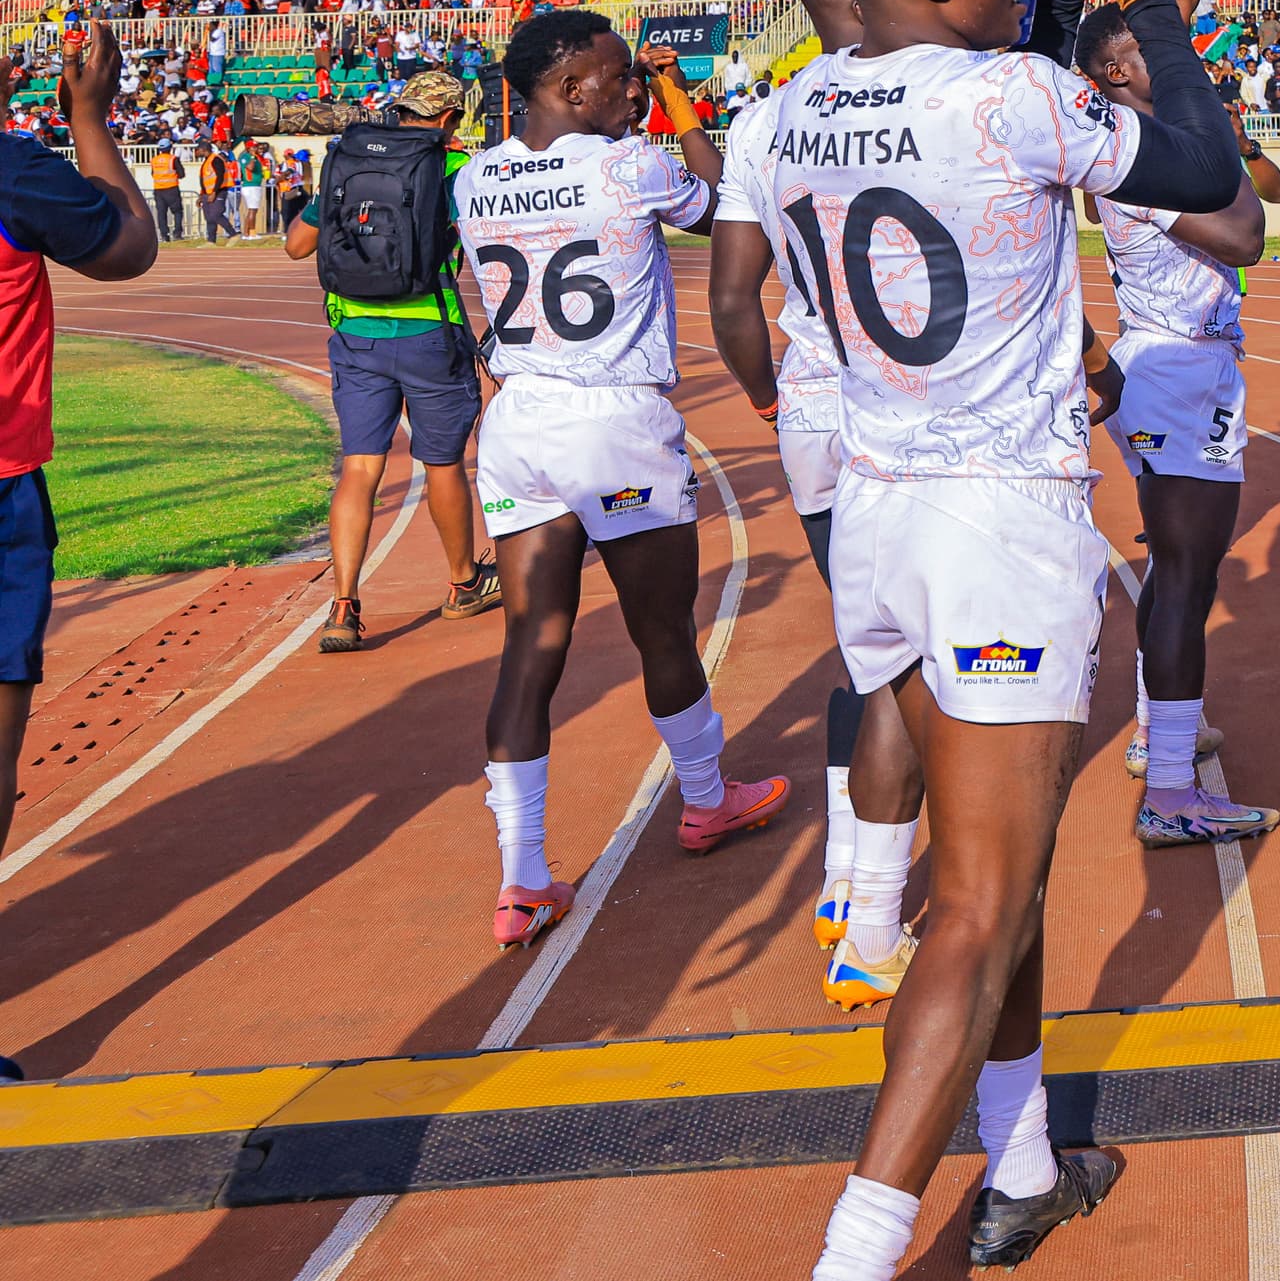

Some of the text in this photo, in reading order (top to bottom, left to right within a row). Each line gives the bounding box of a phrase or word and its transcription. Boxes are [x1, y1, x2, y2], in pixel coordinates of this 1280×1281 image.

[649, 28, 705, 45] GATE 5
[695, 65, 711, 73] EXIT
[468, 184, 587, 219] NYANGIGE
[782, 186, 969, 367] 10
[475, 238, 616, 346] 26
[1208, 406, 1235, 444] 5
[1205, 456, 1228, 465] umbro
[955, 676, 962, 685] If
[963, 678, 978, 687] you
[979, 676, 993, 685] like
[1007, 676, 1031, 685] Crown
